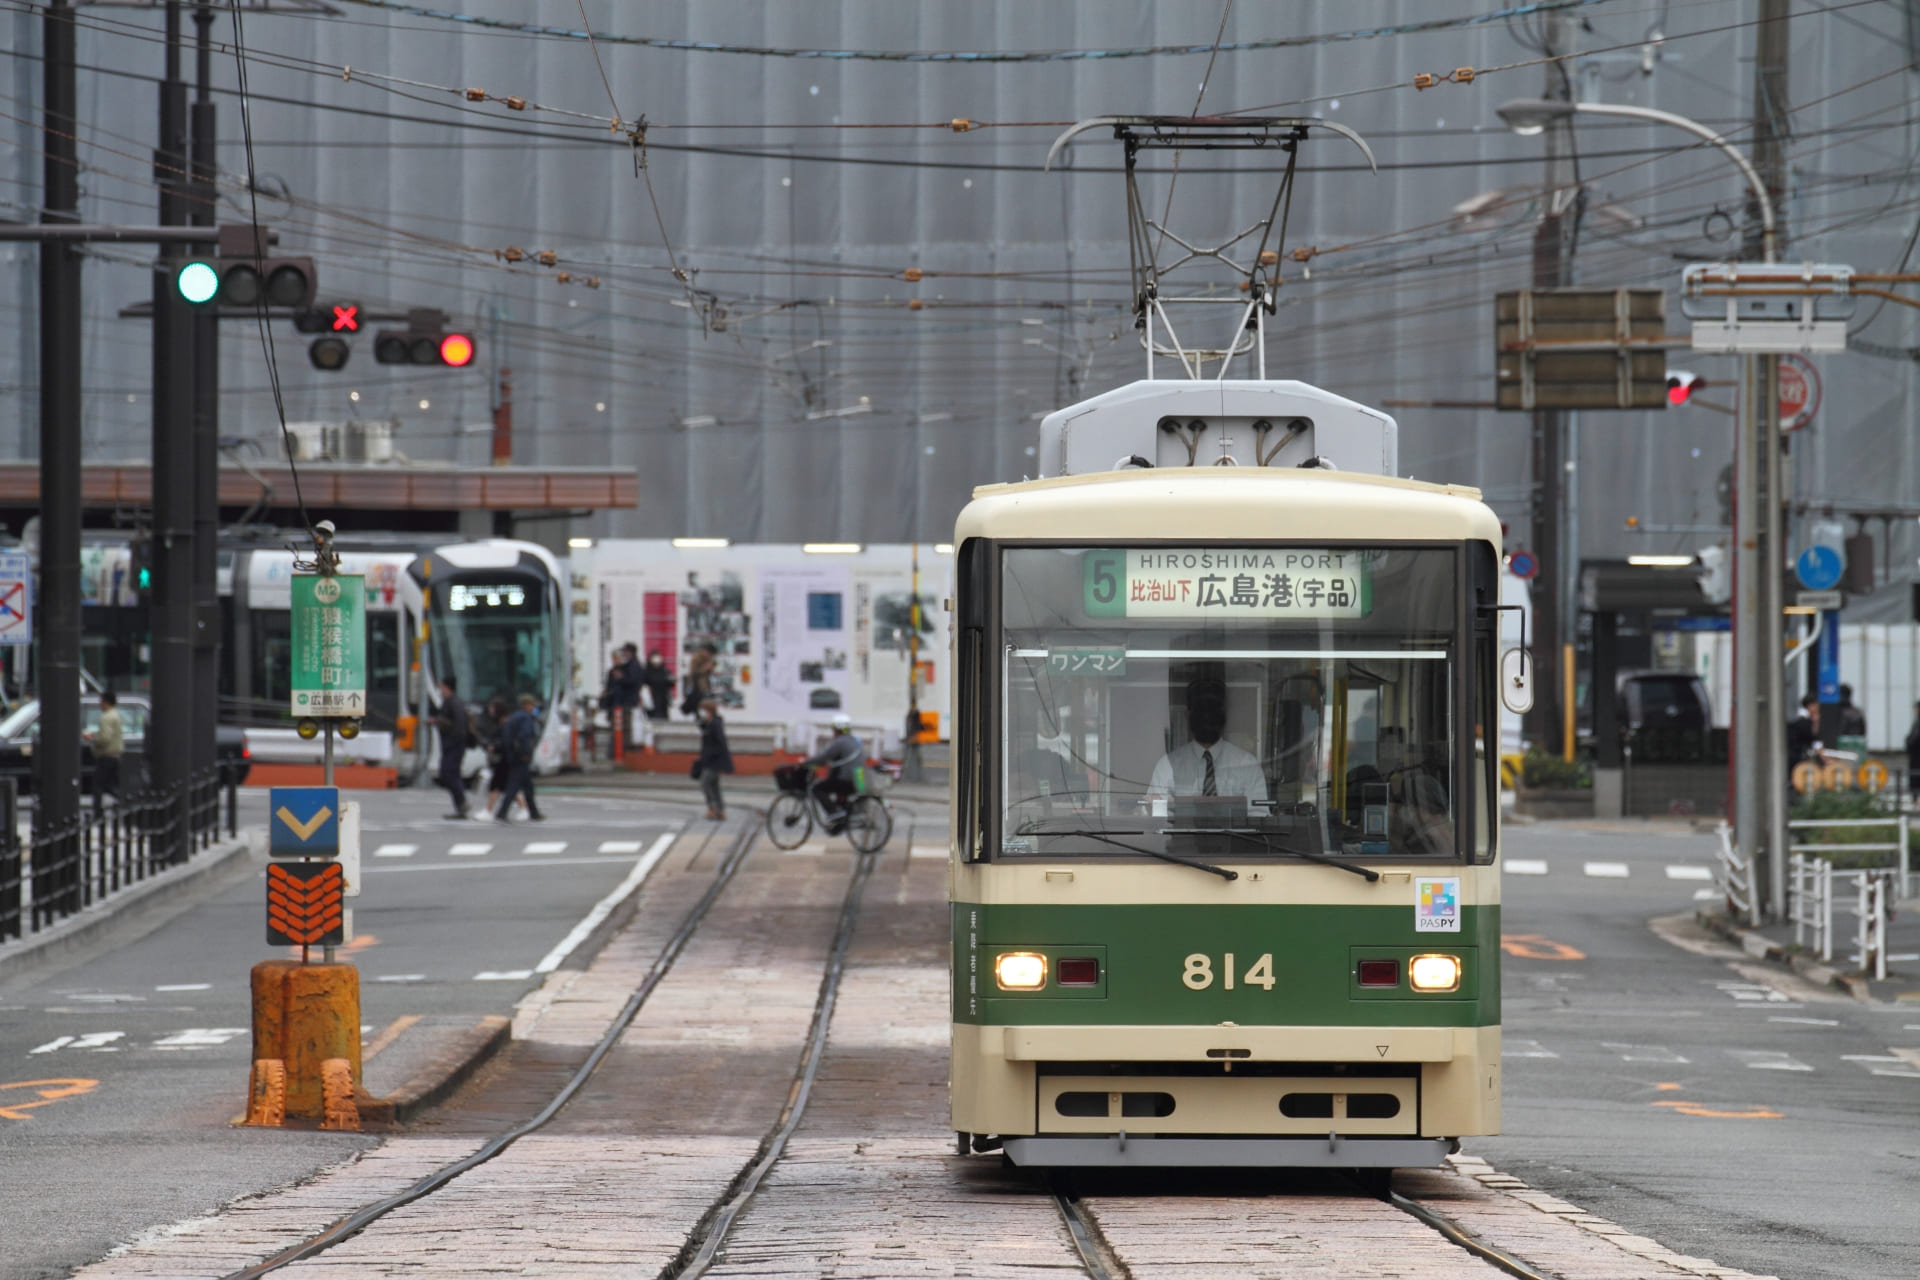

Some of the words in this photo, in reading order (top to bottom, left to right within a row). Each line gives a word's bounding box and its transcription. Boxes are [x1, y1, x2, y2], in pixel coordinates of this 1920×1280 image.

[1140, 554, 1276, 569] HIROSHIMA
[1285, 554, 1347, 569] PORT
[1092, 559, 1117, 604] 5
[318, 585, 337, 597] M2
[1130, 578, 1192, 603] 比治山下
[1195, 572, 1358, 609] 広島港(宇品)
[1051, 654, 1124, 672] ワンマン
[310, 694, 344, 706] 広島駅
[1420, 918, 1456, 928] PASPY
[1181, 952, 1277, 991] 814
